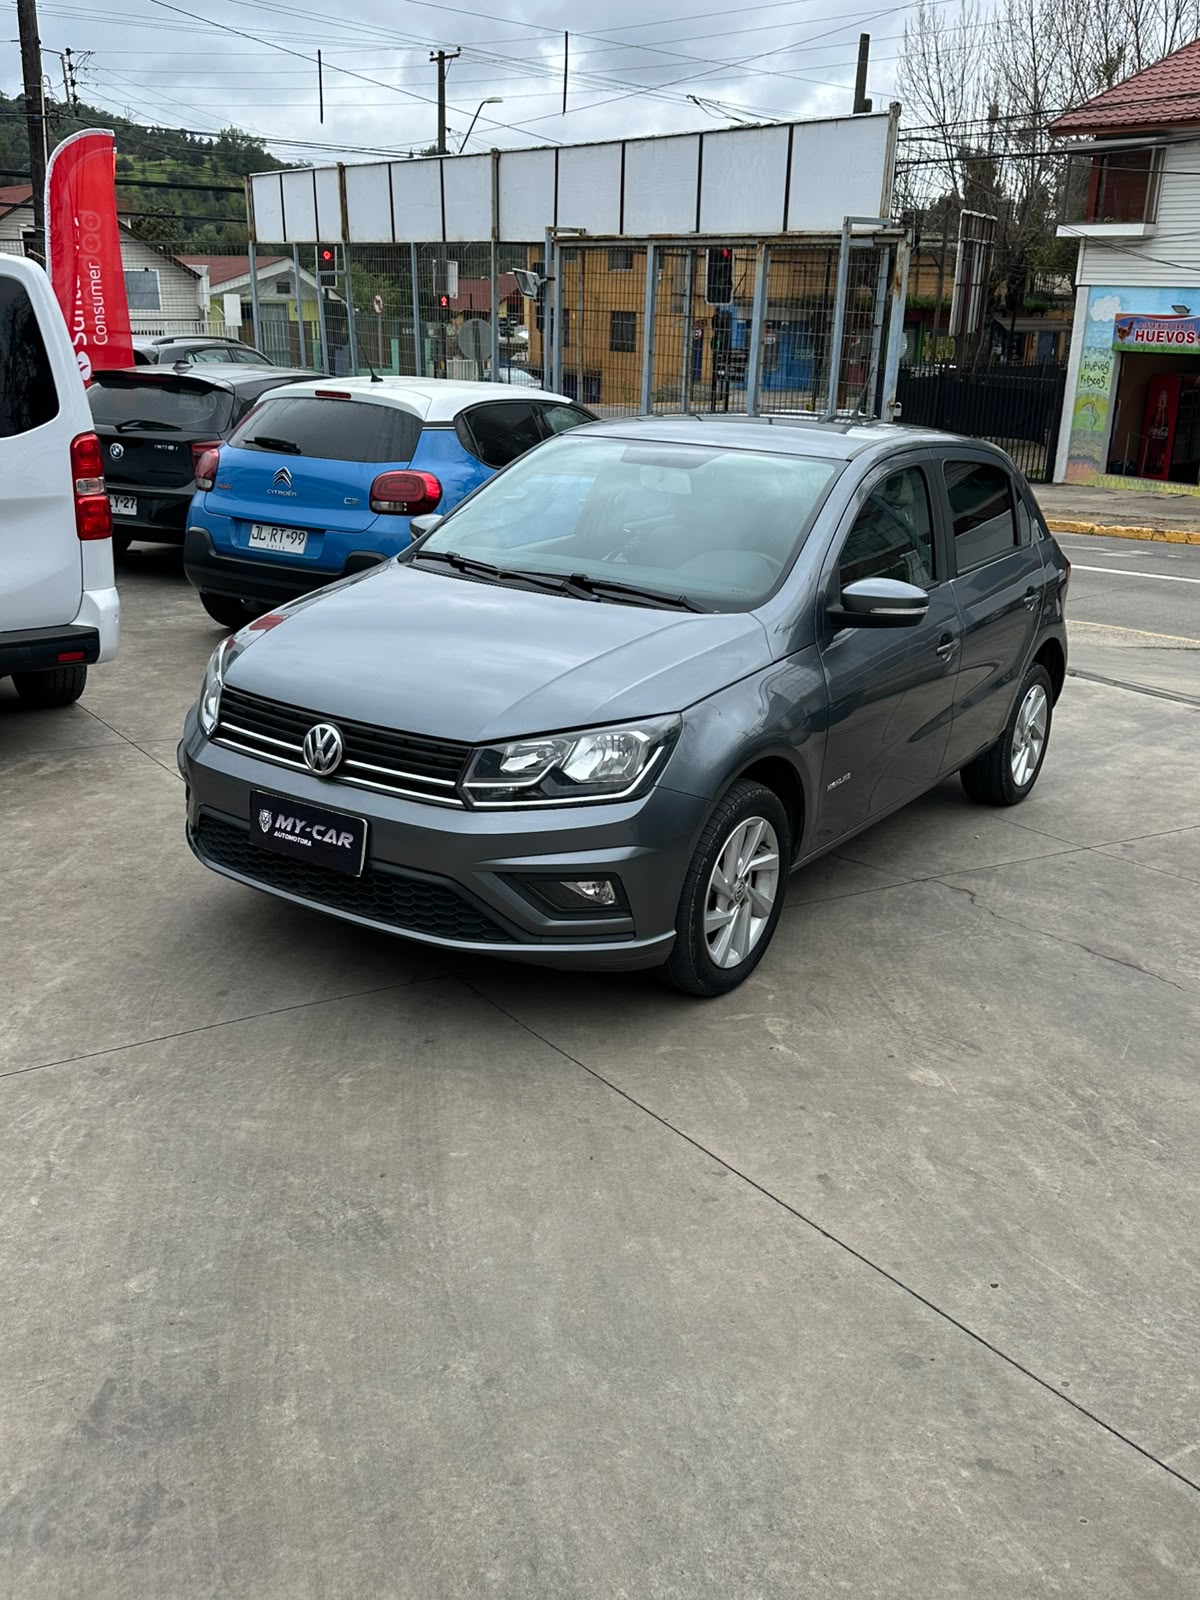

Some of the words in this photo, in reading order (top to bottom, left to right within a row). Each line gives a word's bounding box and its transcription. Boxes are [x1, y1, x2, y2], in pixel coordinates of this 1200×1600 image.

[89, 261, 108, 345] Consumer
[1134, 330, 1195, 344] HUEVOS
[273, 831, 312, 847] AUTOMOTORA
[274, 813, 354, 849] MY-CAR
